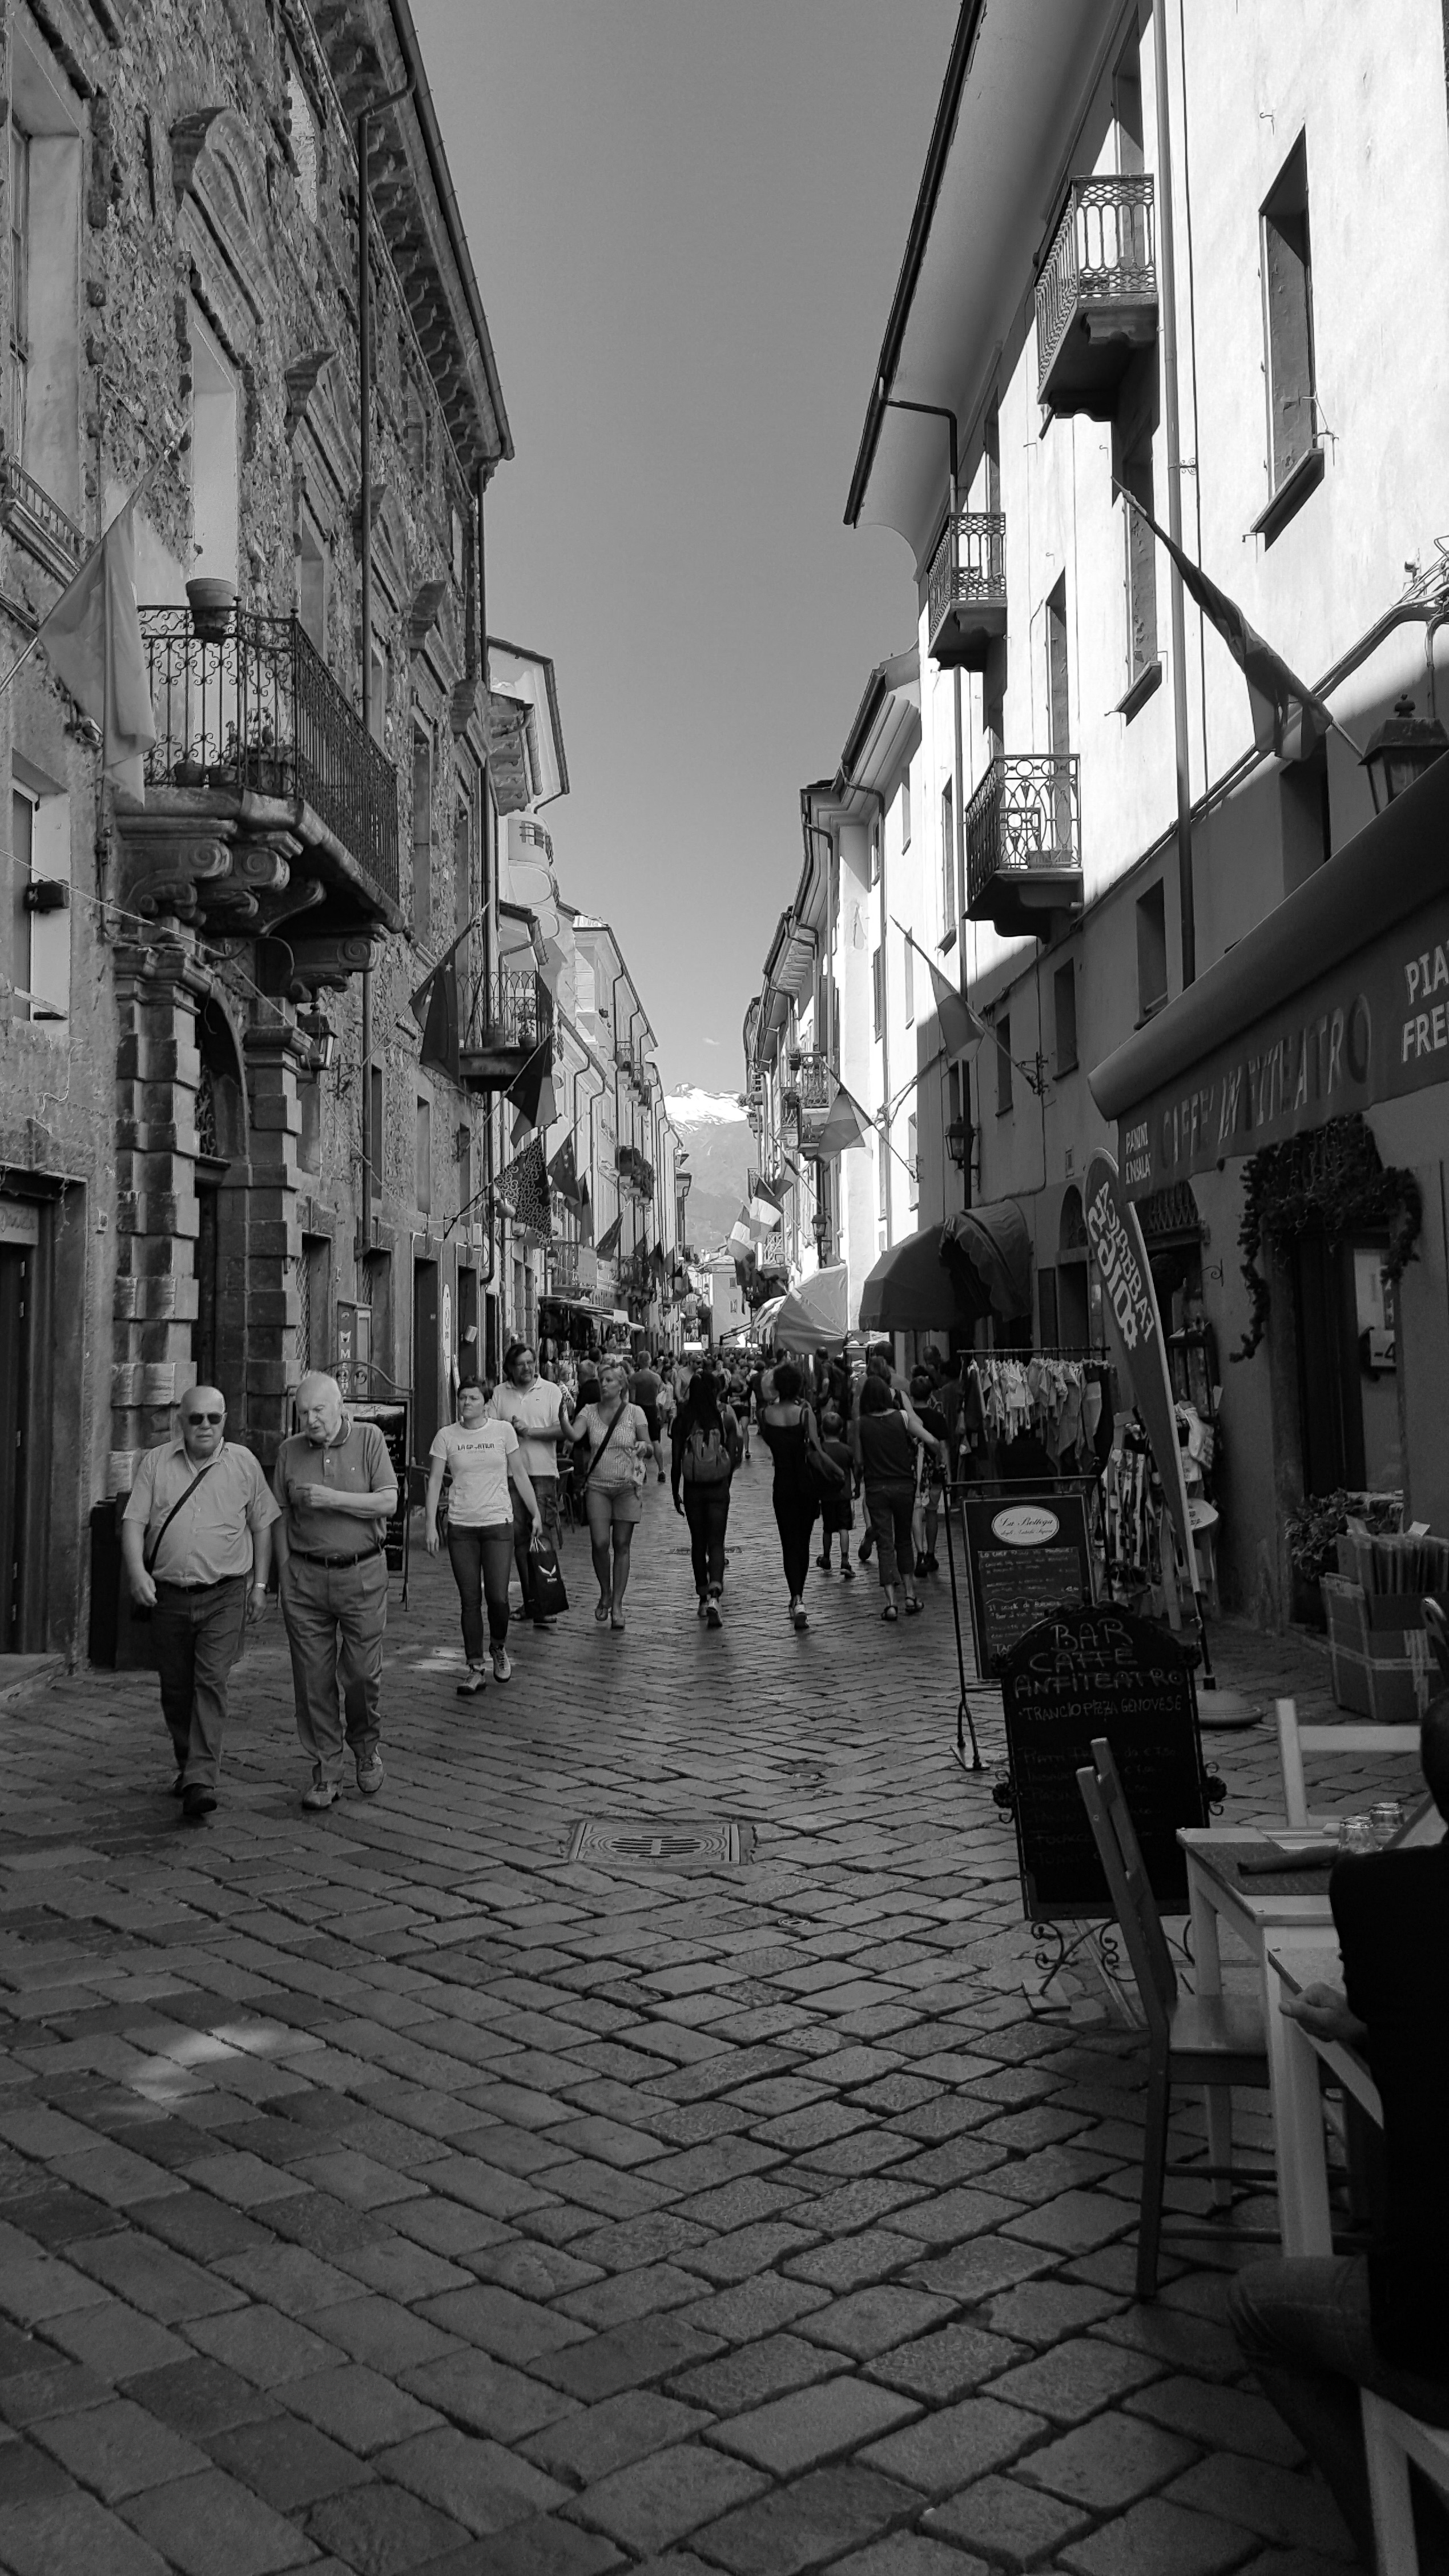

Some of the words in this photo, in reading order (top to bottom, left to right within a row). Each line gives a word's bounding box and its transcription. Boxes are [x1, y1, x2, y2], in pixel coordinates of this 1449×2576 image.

[1404, 939, 1449, 1005] PIA
[1401, 1001, 1449, 1063] FRE
[1000, 1517, 1014, 1526] La
[1018, 1517, 1053, 1527] Bottega
[1049, 1617, 1133, 1653] BAR
[1014, 1667, 1184, 1699] ANFITEATRO
[1121, 1695, 1182, 1713] GENOVESE
